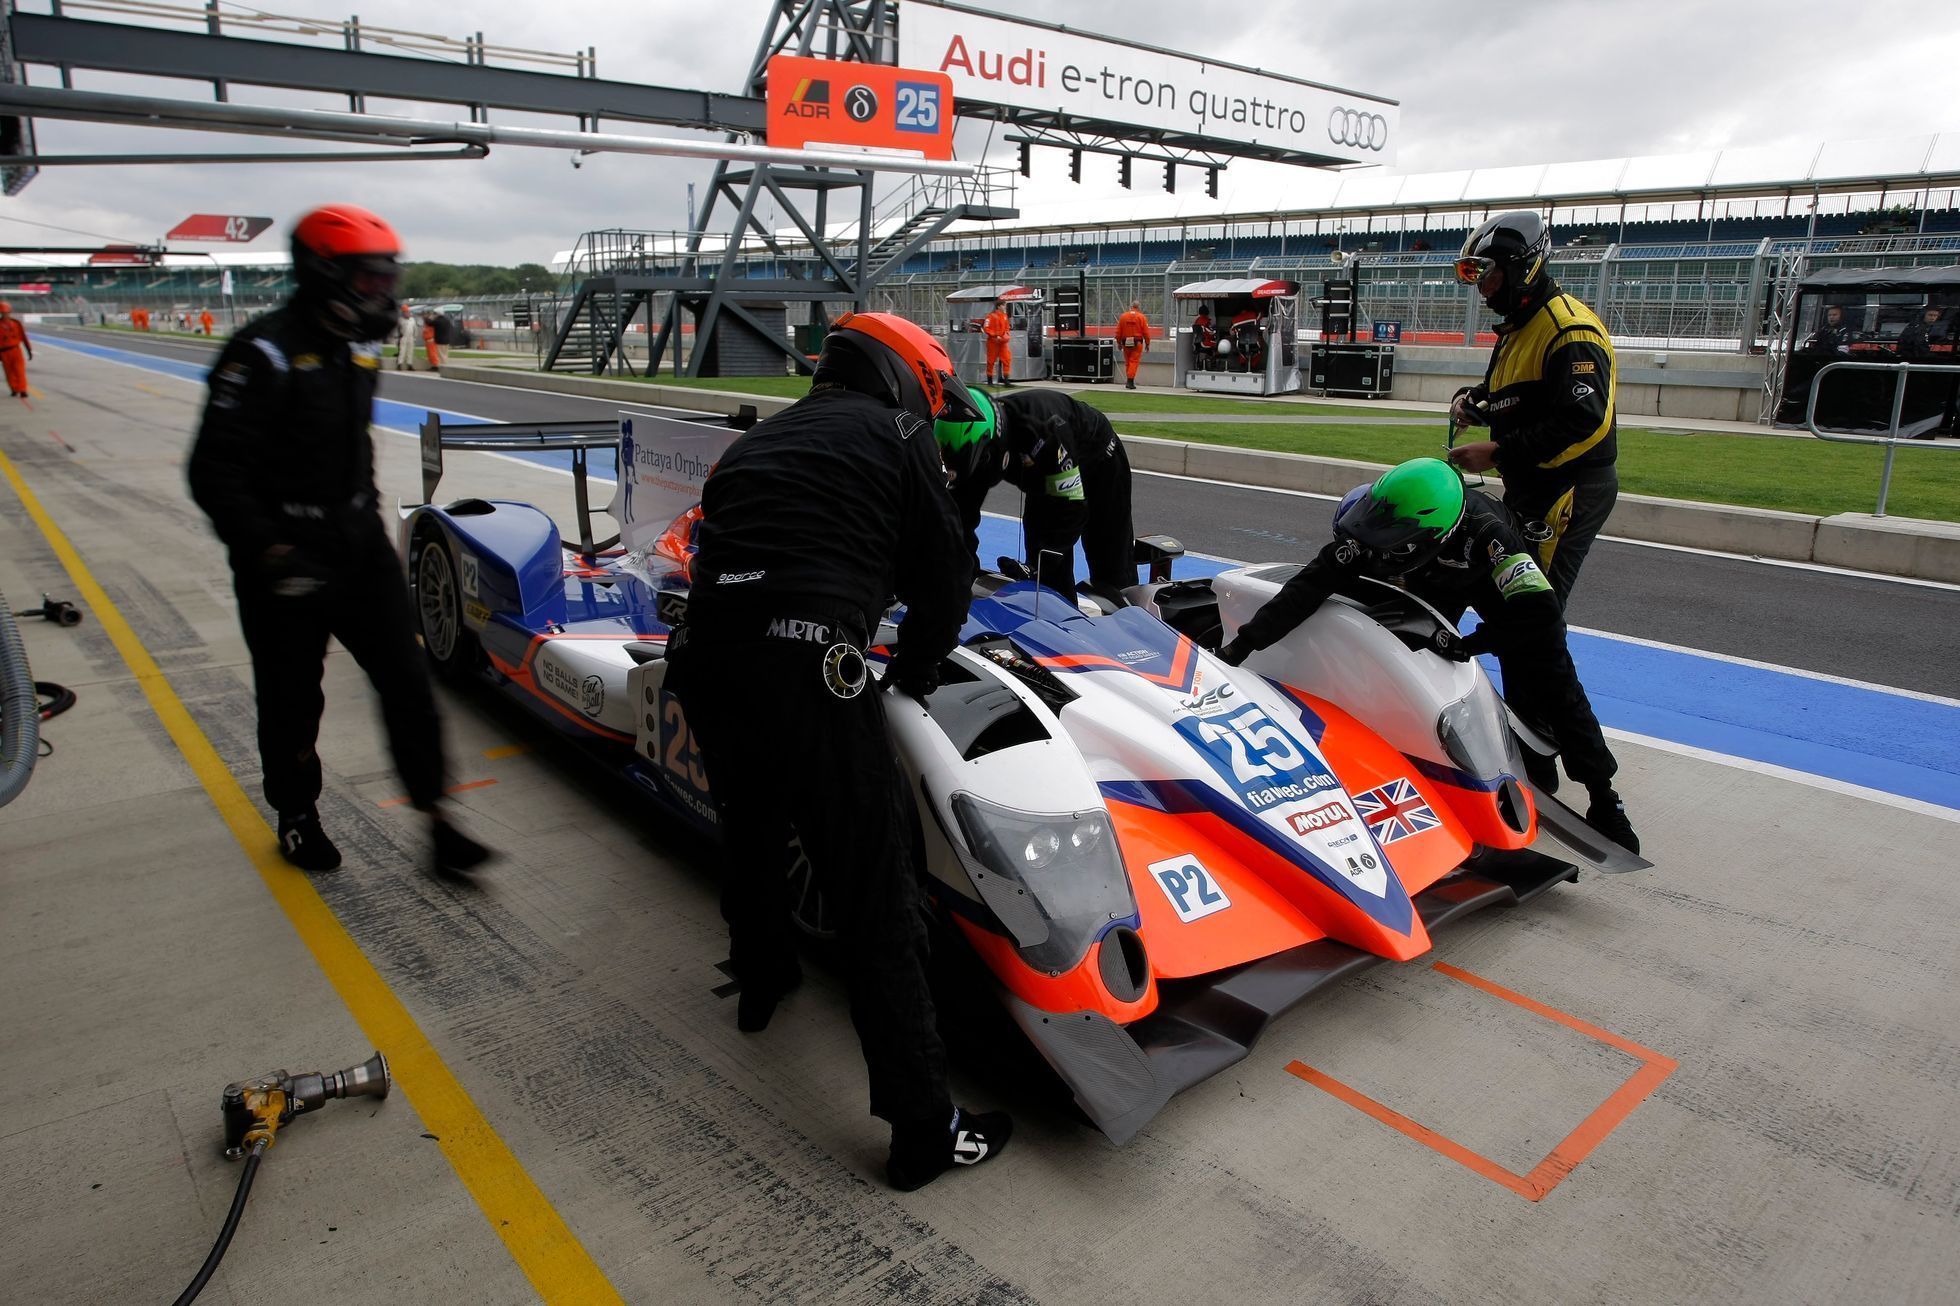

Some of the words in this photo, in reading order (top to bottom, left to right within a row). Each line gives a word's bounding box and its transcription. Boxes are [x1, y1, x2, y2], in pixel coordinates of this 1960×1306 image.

[939, 34, 1046, 88] Audi
[1061, 65, 1176, 110] e-tron
[1188, 88, 1306, 134] quattro
[783, 102, 830, 119] ADR
[896, 87, 938, 127] 25
[225, 216, 250, 241] 42
[1032, 288, 1042, 299] 41
[1571, 362, 1595, 375] OMP
[635, 443, 672, 474] Pattaya
[674, 452, 711, 481] Orpha
[462, 559, 477, 593] P2
[716, 570, 766, 585] sparco
[1499, 560, 1536, 591] WEC
[765, 617, 830, 645] MRTC
[543, 659, 554, 673] NO
[555, 665, 578, 689] BALLS
[543, 670, 554, 684] NO
[1180, 682, 1234, 709] WEC
[1197, 708, 1306, 784] 25
[1246, 773, 1336, 808] fiawec.com
[1293, 803, 1349, 834] MOTUL
[1158, 864, 1222, 913] P2
